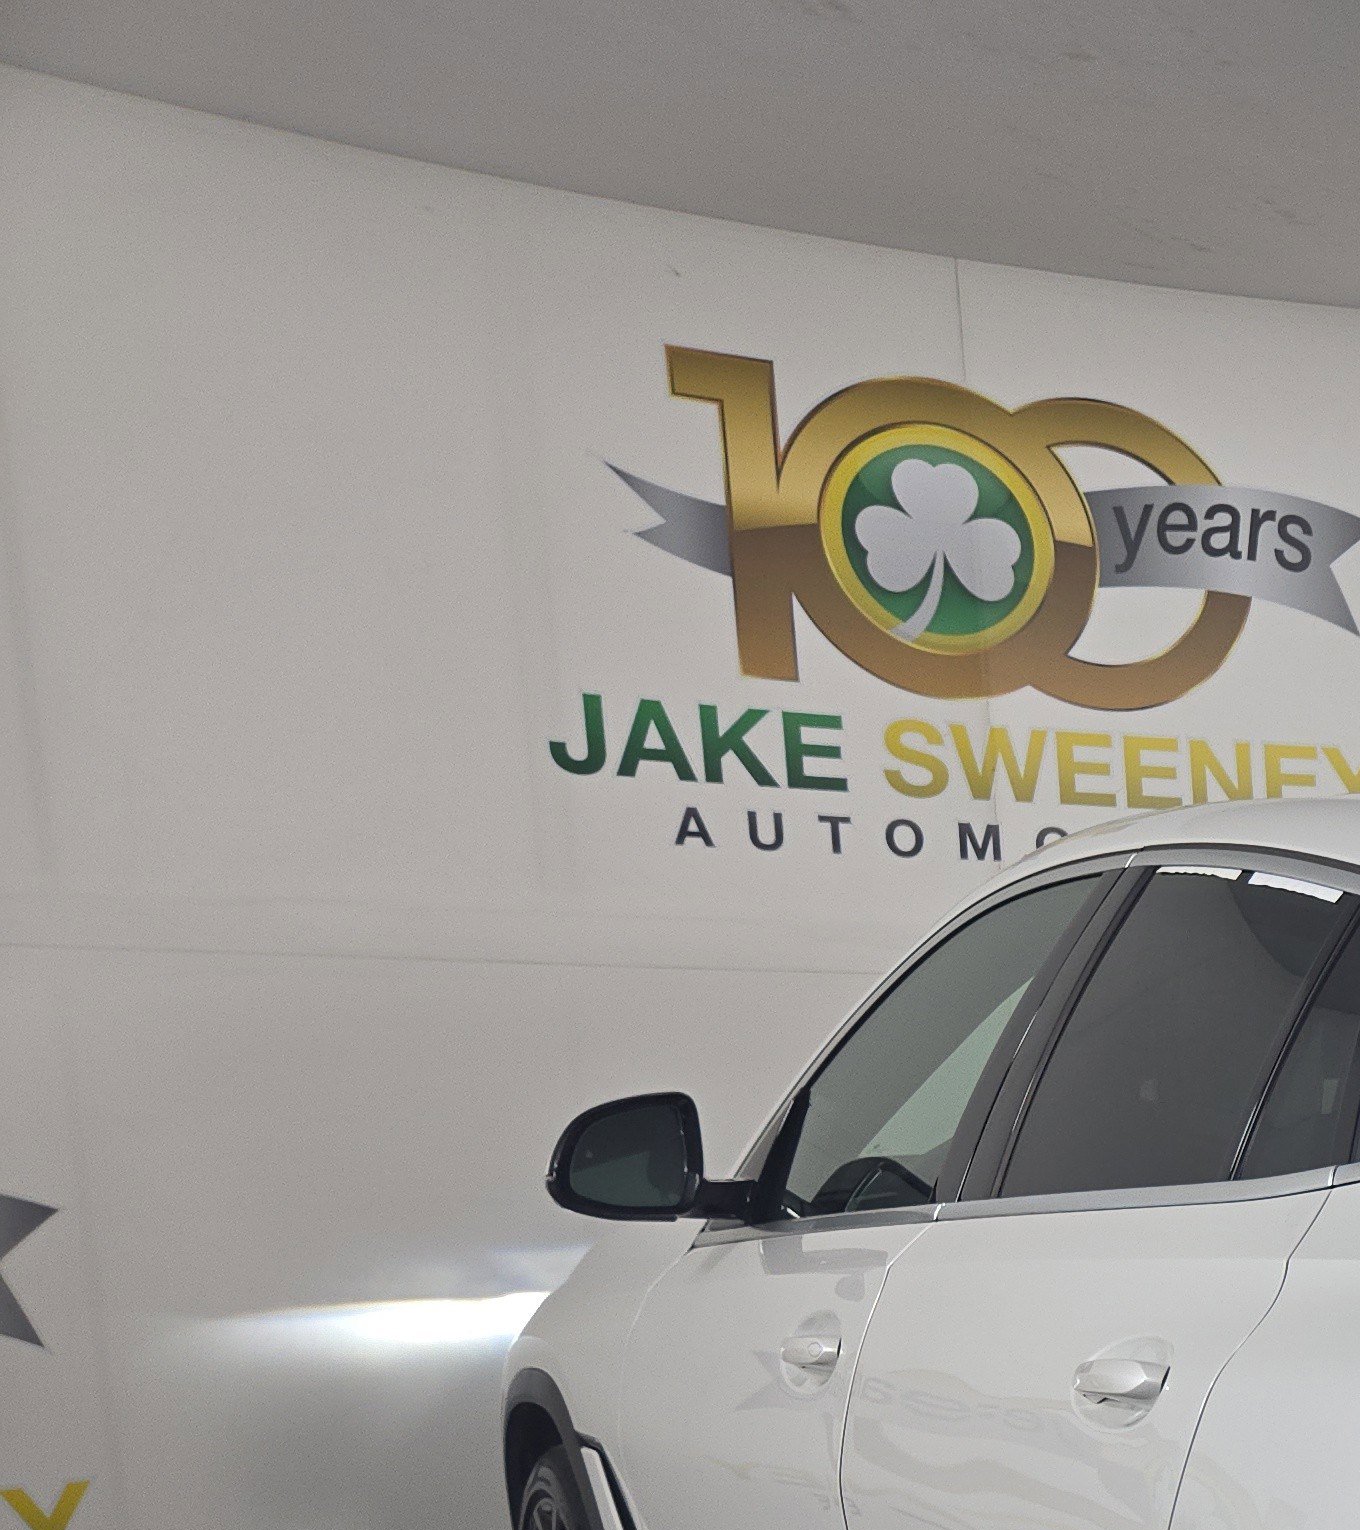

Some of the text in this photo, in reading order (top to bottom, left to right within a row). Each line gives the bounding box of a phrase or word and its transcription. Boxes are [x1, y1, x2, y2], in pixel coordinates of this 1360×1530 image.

[664, 345, 1314, 711] 100 years
[548, 693, 848, 792] JAKE
